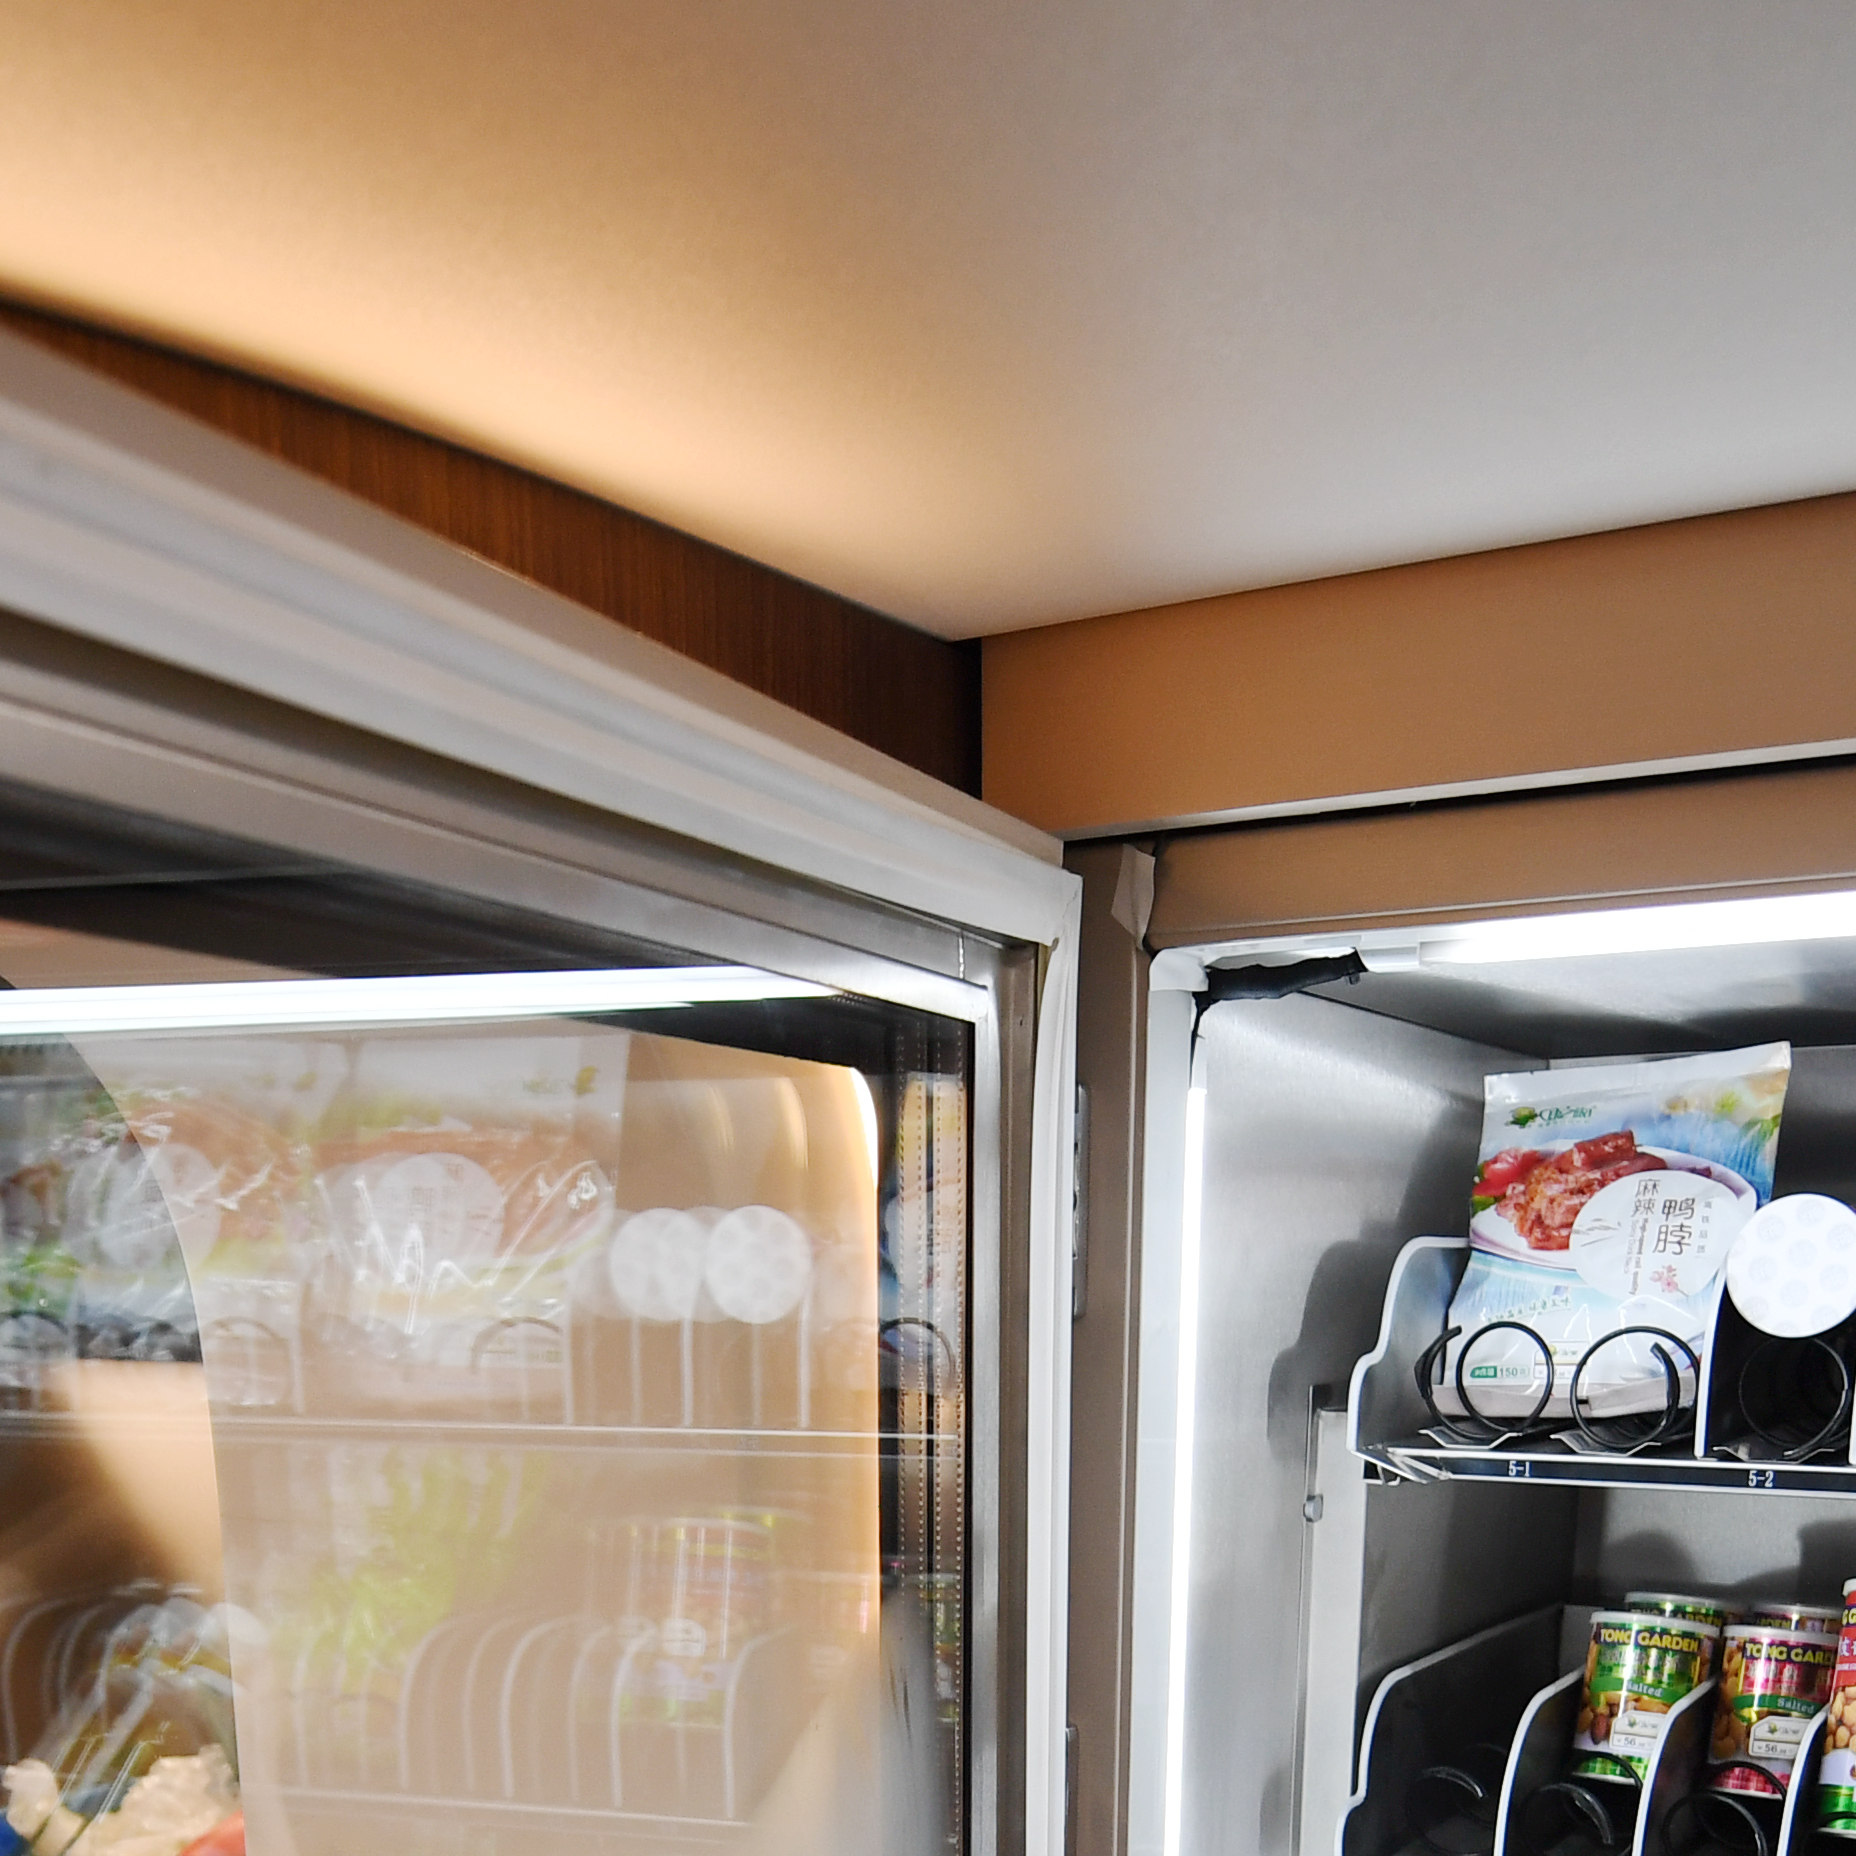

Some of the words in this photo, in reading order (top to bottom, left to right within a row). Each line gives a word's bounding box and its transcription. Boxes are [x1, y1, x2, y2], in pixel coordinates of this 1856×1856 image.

[1631, 1178, 1661, 1217] 麻辣
[1652, 1197, 1696, 1256] 鸭脖
[1508, 1461, 1531, 1477] 5-1
[1748, 1470, 1775, 1488] 5-2
[1638, 1632, 1699, 1652] GARDEN
[1745, 1643, 1788, 1660] TONG
[1777, 1698, 1815, 1714] Salted
